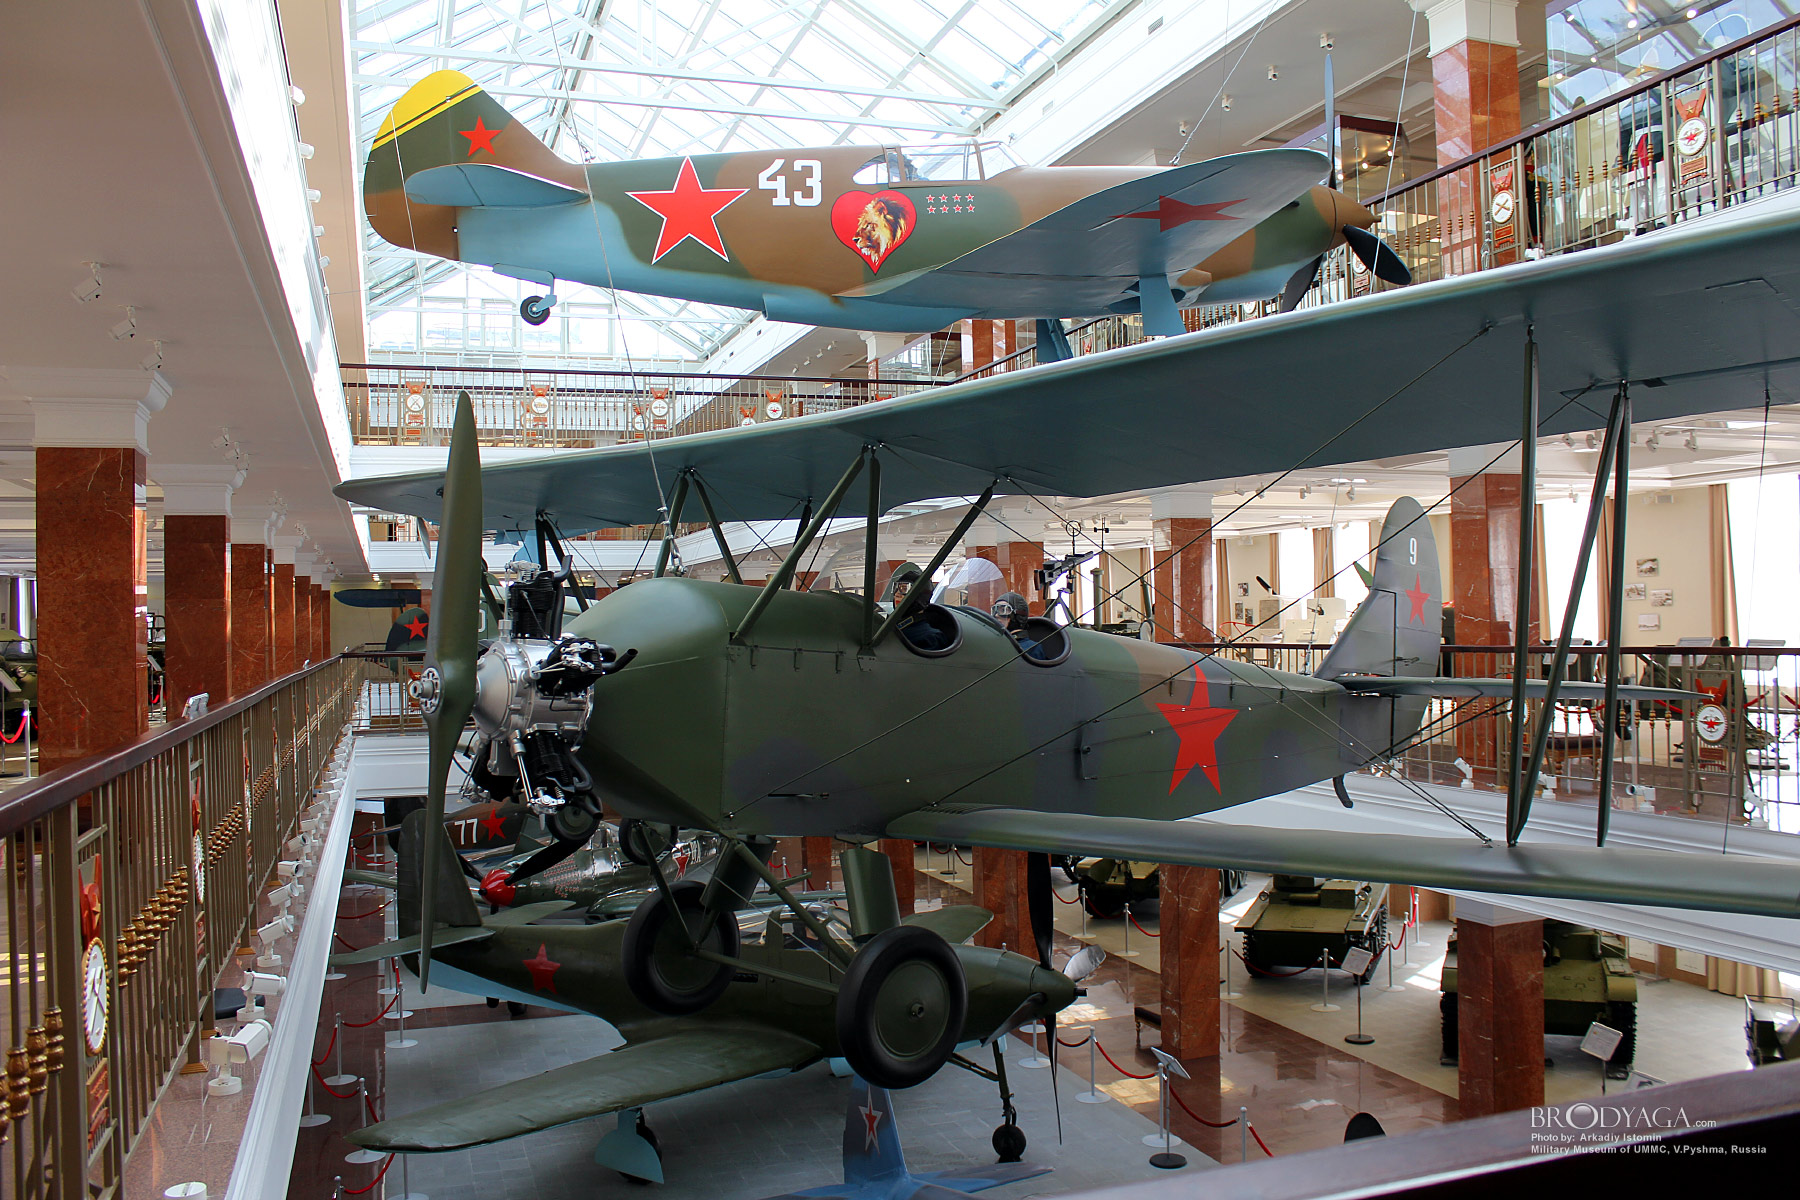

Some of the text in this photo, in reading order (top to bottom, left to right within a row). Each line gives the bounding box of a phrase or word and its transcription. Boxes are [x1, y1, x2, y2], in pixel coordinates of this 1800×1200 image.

[758, 158, 822, 207] 43
[1409, 537, 1417, 565] 9
[454, 818, 478, 845] 77
